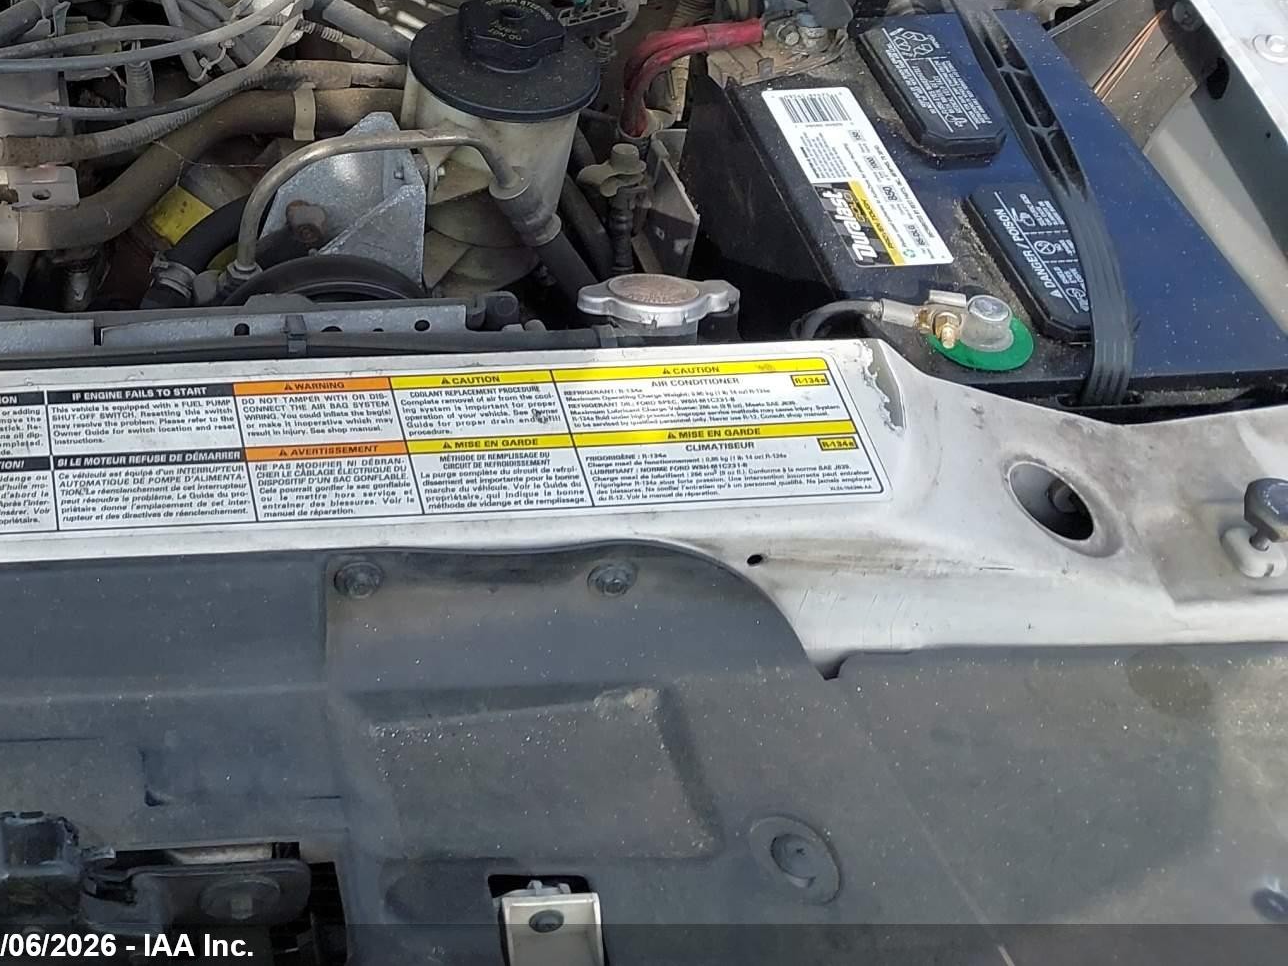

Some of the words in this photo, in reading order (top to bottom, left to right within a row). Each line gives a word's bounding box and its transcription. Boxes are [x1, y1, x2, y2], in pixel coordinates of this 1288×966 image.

[881, 186, 898, 200] 850
[823, 190, 878, 260] Duralast
[994, 208, 1024, 242] POISON
[1022, 250, 1056, 289] DANGER
[672, 366, 720, 375] CAUTION
[452, 375, 500, 384] CAUTION
[669, 377, 739, 386] CONDITIONER
[294, 382, 344, 391] WARNING
[410, 390, 442, 398] COOLANT
[444, 387, 496, 396] REPLACEMENT
[498, 385, 540, 394] PROCEDURE
[72, 392, 81, 401] IF
[83, 391, 122, 400] ENGINE
[125, 389, 153, 398] FAILS
[157, 389, 170, 397] TO
[173, 387, 207, 396] START
[283, 395, 320, 403] TAMPER
[324, 394, 348, 402] WITH
[70, 405, 99, 413] vehicle
[111, 403, 150, 412] equipped
[205, 399, 231, 407] PUMP
[243, 405, 285, 413] CONNECT
[329, 402, 348, 410] BAG
[352, 400, 390, 409] SYSTEM
[52, 413, 94, 421] SHUT-OFF
[140, 409, 181, 419] Resetting
[184, 408, 200, 416] this
[204, 407, 232, 415] switch
[298, 411, 321, 419] could
[322, 410, 348, 418] inflate
[293, 418, 342, 428] inoperative
[345, 417, 372, 425] which
[374, 417, 393, 425] may
[247, 429, 271, 437] result
[327, 426, 347, 435] shop
[679, 431, 704, 439] MISE
[706, 430, 721, 438] EN
[724, 428, 761, 437] GARDE
[454, 440, 480, 449] MISE
[483, 440, 498, 448] EN
[501, 438, 538, 447] GARDE
[685, 441, 755, 452] CLIMATISEUR
[822, 440, 854, 448] R-134a
[290, 445, 379, 456] AVERTISSEMENT
[57, 458, 67, 467] SI
[69, 458, 82, 466] LE
[83, 456, 126, 466] MOTEUR
[128, 454, 166, 464] REFUSE
[168, 454, 182, 462] DE
[184, 449, 240, 461] DÉMARRER
[439, 452, 475, 463] MÉTHODE
[487, 452, 538, 461] REMPLISSAGE
[443, 462, 470, 470] CIRCUIT
[483, 458, 550, 468] REFROIDISSEMENT
